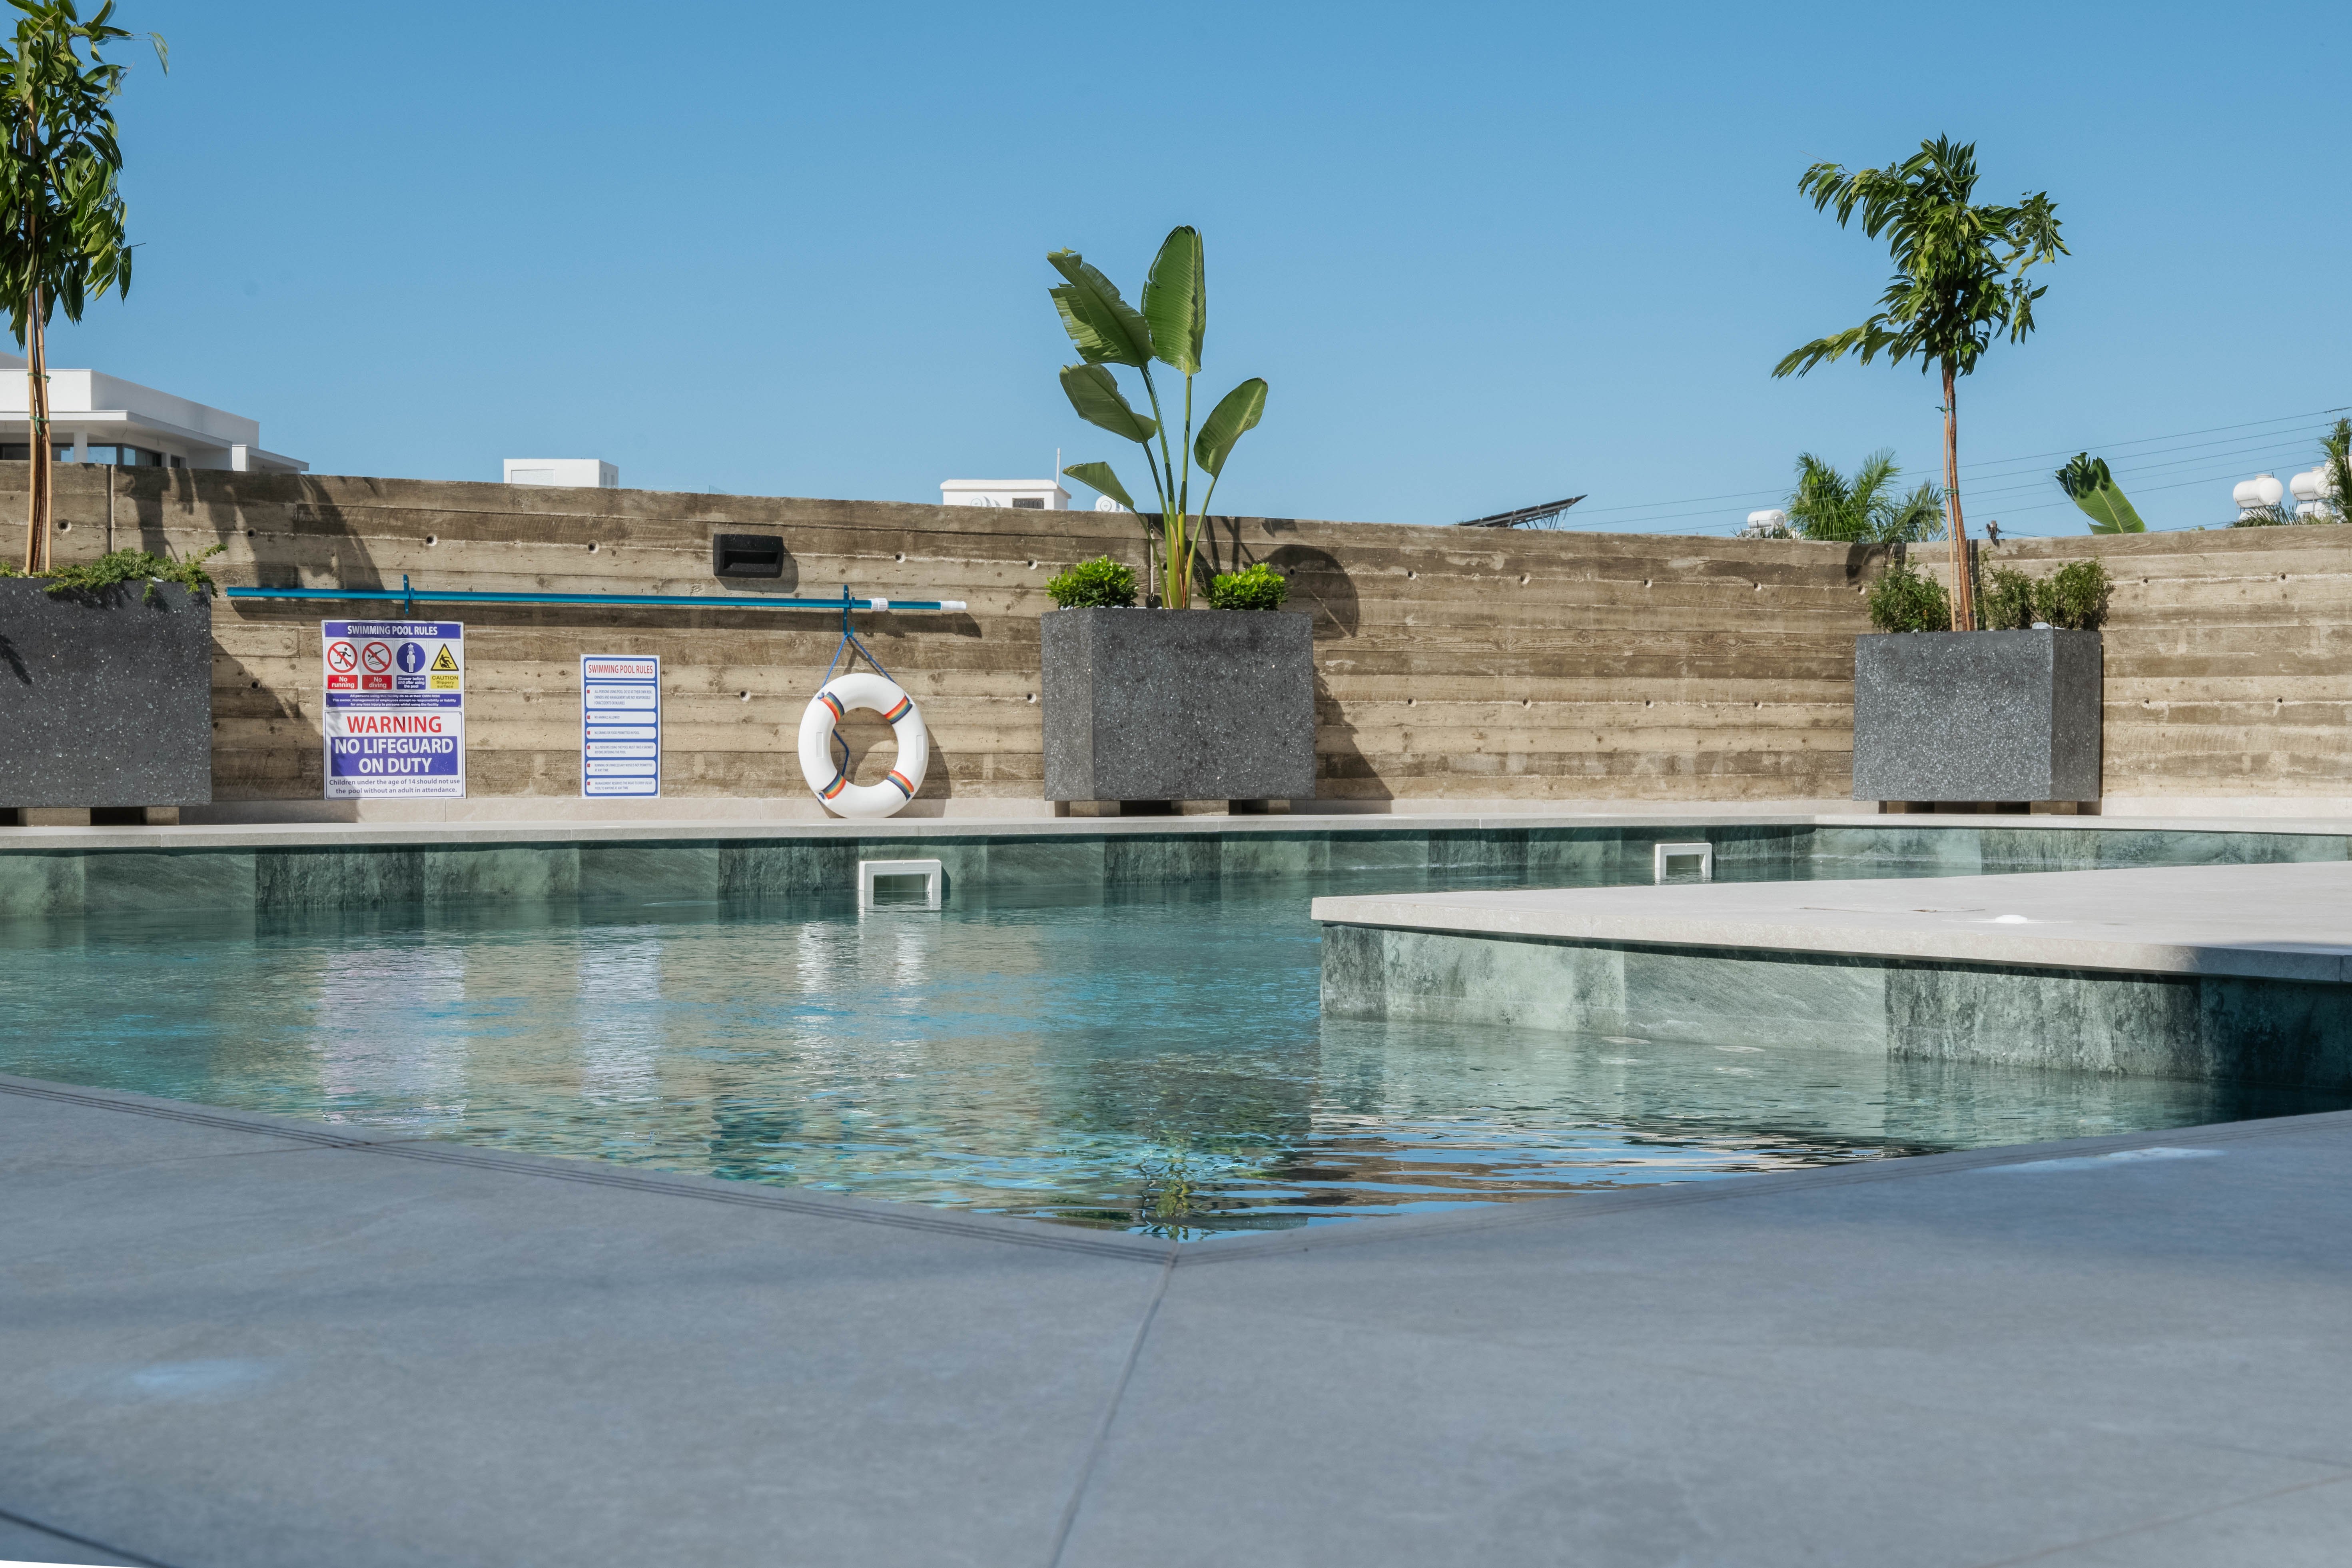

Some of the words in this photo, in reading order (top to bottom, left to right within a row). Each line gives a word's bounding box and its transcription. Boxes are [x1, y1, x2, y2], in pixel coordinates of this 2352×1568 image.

[348, 625, 390, 635] SWIMMING
[392, 626, 413, 635] POOL
[414, 626, 437, 635] RULES
[588, 665, 618, 673] SWIMMING
[347, 716, 441, 733] WARNING
[335, 739, 360, 754] NO
[364, 739, 453, 754] LIFEGUARD
[359, 758, 383, 773] ON
[388, 758, 432, 773] DUTY
